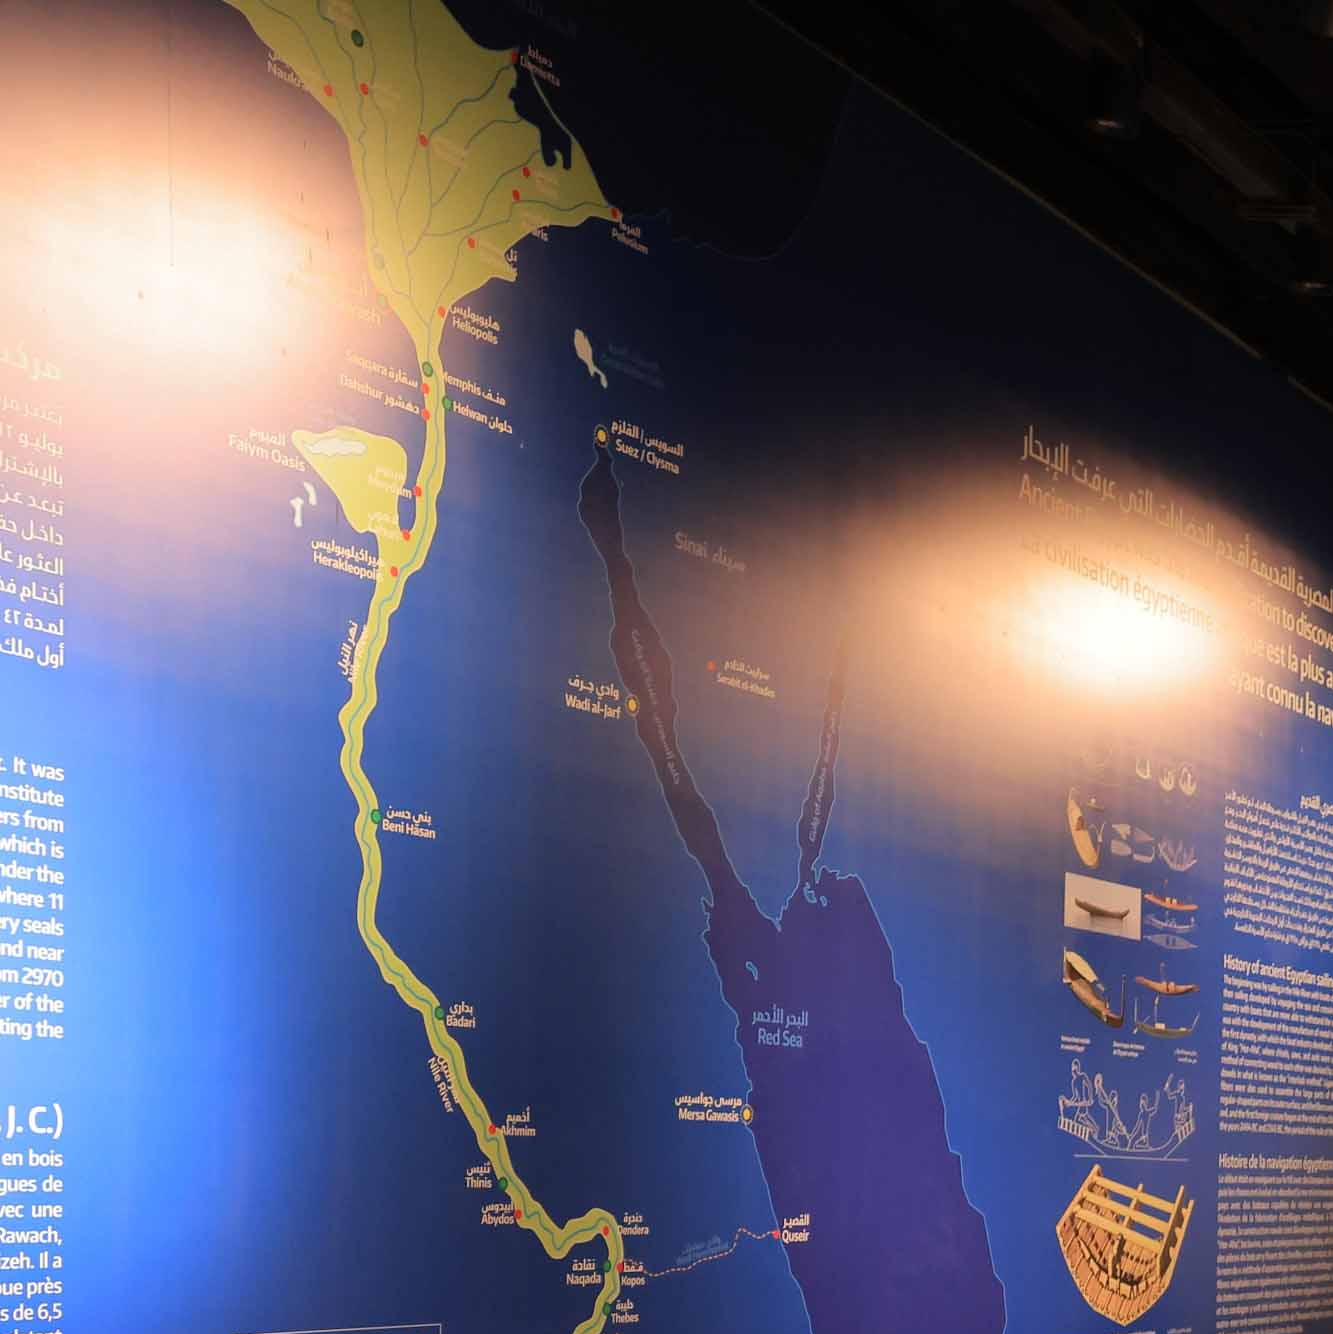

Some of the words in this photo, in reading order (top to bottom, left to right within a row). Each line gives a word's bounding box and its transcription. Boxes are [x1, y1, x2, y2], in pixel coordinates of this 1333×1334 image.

[452, 317, 498, 344] Heliopolis
[453, 401, 488, 425] Helwan
[271, 449, 306, 472] Oasis
[615, 438, 640, 459] Suez
[646, 451, 681, 475] Clysma
[1021, 425, 1069, 480] الإبحار
[1071, 459, 1117, 501] عرفت
[27, 494, 64, 518] تبعد
[21, 519, 64, 546] داخل
[674, 528, 709, 560] Sinai
[1019, 473, 1084, 522] Ancient
[1282, 607, 1295, 631] to
[16, 551, 64, 576] العثور
[1250, 551, 1296, 592] القديمة
[20, 581, 64, 606] أختام
[1046, 541, 1130, 596] civilisation
[1266, 643, 1287, 669] est
[1288, 645, 1299, 673] la
[1300, 654, 1325, 685] plus
[24, 612, 64, 636] لمدة
[0, 637, 34, 659] ملك
[37, 642, 64, 669] أول
[567, 673, 595, 692] جرف
[595, 682, 620, 701] وادي
[565, 690, 591, 712] Wadi
[1266, 682, 1303, 715] connu
[1305, 692, 1316, 719] la
[13, 756, 27, 775] It
[31, 763, 65, 781] was
[23, 809, 64, 833] from
[386, 805, 412, 820] حسن
[382, 818, 405, 833] Beni
[51, 840, 65, 859] is
[36, 863, 65, 884] the
[48, 892, 64, 911] 11
[23, 917, 64, 936] seals
[27, 944, 64, 961] near
[22, 966, 64, 988] 2970
[1223, 953, 1250, 977] History
[1251, 957, 1260, 974] of
[1260, 961, 1286, 980] ancient
[1285, 965, 1317, 987] Egyptian
[14, 991, 34, 1011] of
[36, 993, 64, 1013] the
[449, 1001, 474, 1018] بداري
[446, 1015, 476, 1029] Badari
[751, 1003, 784, 1025] الأحمر
[784, 1011, 809, 1028] البحر
[36, 1019, 64, 1040] the
[757, 1028, 781, 1046] Red
[782, 1031, 803, 1048] Sea
[428, 1055, 441, 1083] Nile
[436, 1079, 454, 1114] River
[6, 1104, 24, 1139] J.
[678, 1107, 705, 1121] Mersa
[706, 1109, 739, 1122] Gawasis
[501, 1124, 536, 1137] Akhmim
[2, 1152, 24, 1167] en
[29, 1148, 64, 1167] bois
[1218, 1152, 1248, 1170] Histoire
[1249, 1153, 1258, 1169] de
[1258, 1153, 1266, 1169] la
[1266, 1154, 1303, 1173] navigation
[42, 1173, 64, 1193] de
[464, 1176, 493, 1189] Thinis
[31, 1204, 63, 1219] une
[480, 1213, 515, 1227] Abydos
[0, 1226, 62, 1246] Rawach,
[616, 1223, 649, 1236] Dendera
[782, 1229, 810, 1243] Quseir
[39, 1251, 49, 1269] Il
[52, 1255, 63, 1269] a
[26, 1276, 63, 1299] près
[566, 1273, 602, 1288] Naqada
[13, 1303, 35, 1321] de
[37, 1302, 63, 1323] 6,5
[611, 1312, 639, 1325] Thebes
